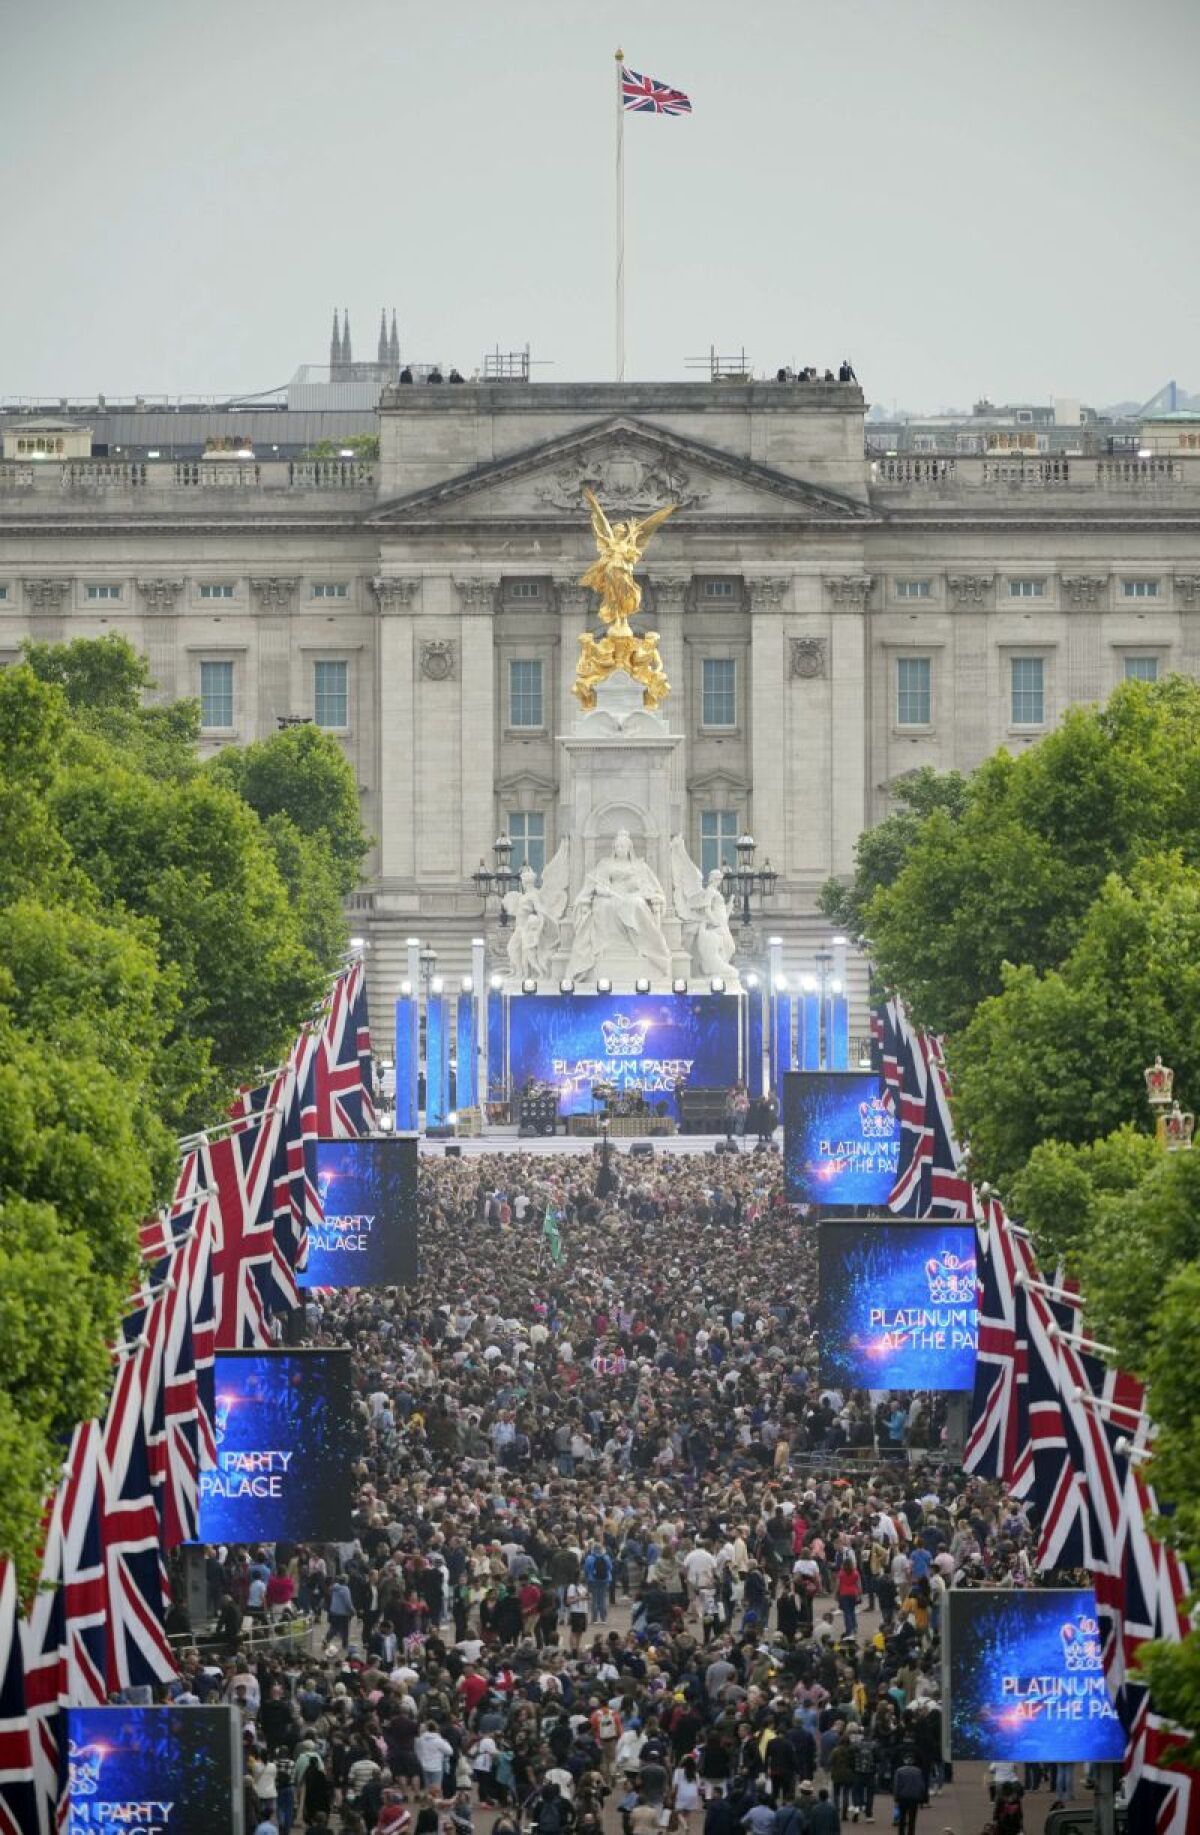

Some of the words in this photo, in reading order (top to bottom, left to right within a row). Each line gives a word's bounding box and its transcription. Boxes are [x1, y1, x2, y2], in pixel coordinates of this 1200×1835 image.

[552, 1059, 637, 1075] PLATINUM
[643, 1059, 695, 1075] PARTY
[563, 1077, 583, 1092] AT
[819, 1141, 889, 1156] PLATINUM
[847, 1158, 874, 1173] THE
[324, 1215, 375, 1231] PARTY
[307, 1235, 368, 1251] PALACE
[940, 1251, 958, 1268] 70
[870, 1309, 967, 1327] PLATINUM
[881, 1330, 903, 1349] AT
[908, 1331, 945, 1349] THE
[224, 1451, 293, 1472] PARTY
[200, 1476, 283, 1498] PALACE
[1002, 1676, 1105, 1697] PLATINUM
[1013, 1699, 1037, 1719] AT
[1043, 1700, 1083, 1719] THE
[98, 1802, 174, 1823] PARTY
